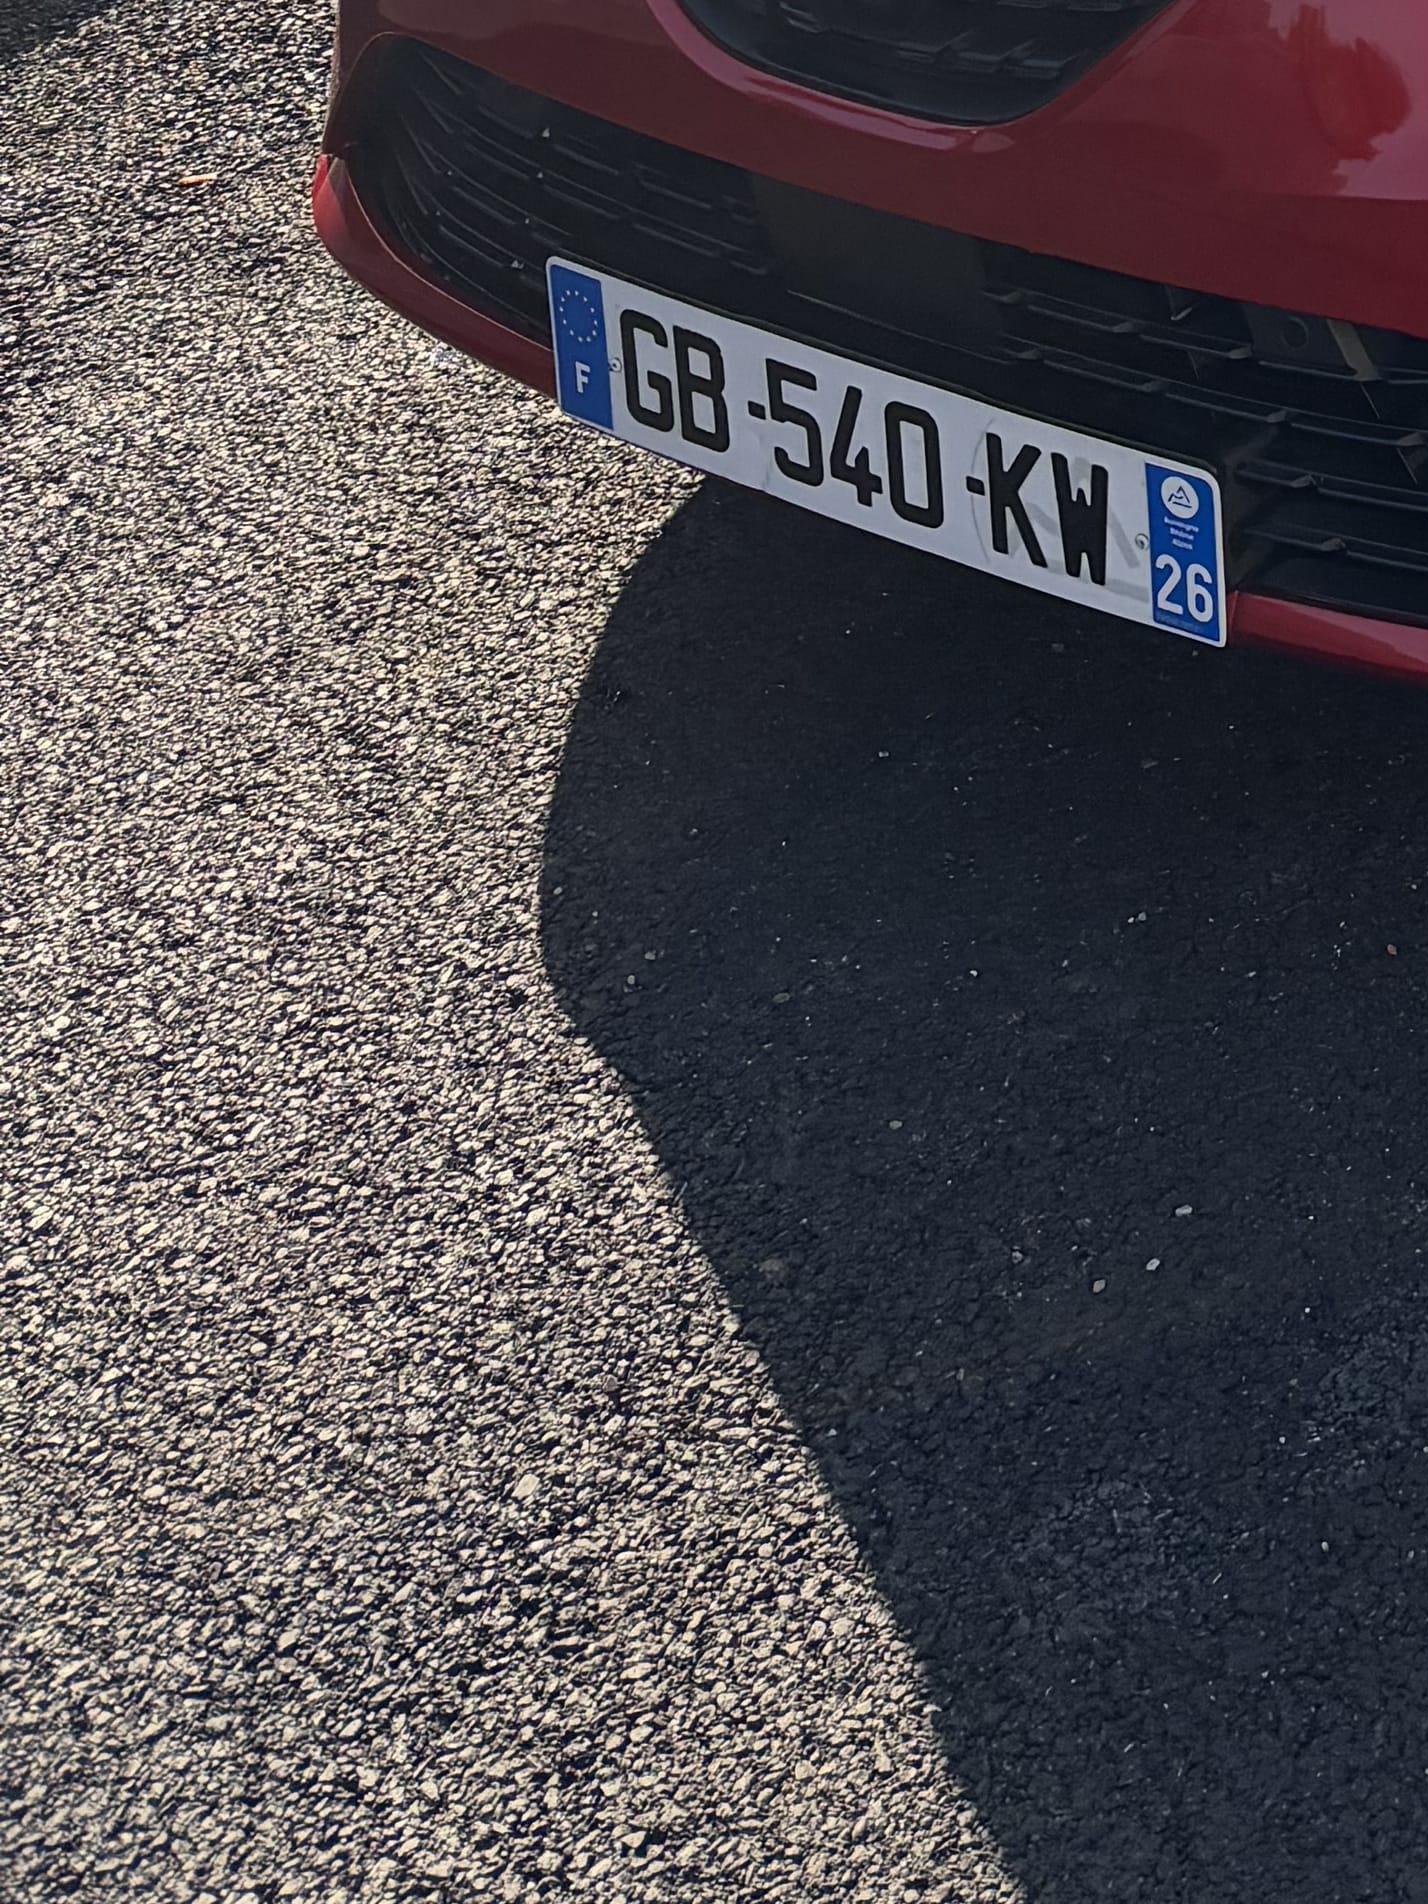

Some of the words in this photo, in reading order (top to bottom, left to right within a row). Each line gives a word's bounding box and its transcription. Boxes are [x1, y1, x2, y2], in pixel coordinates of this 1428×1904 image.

[575, 361, 591, 393] F
[619, 308, 1109, 587] GB-540-KW
[1155, 553, 1214, 623] 26
